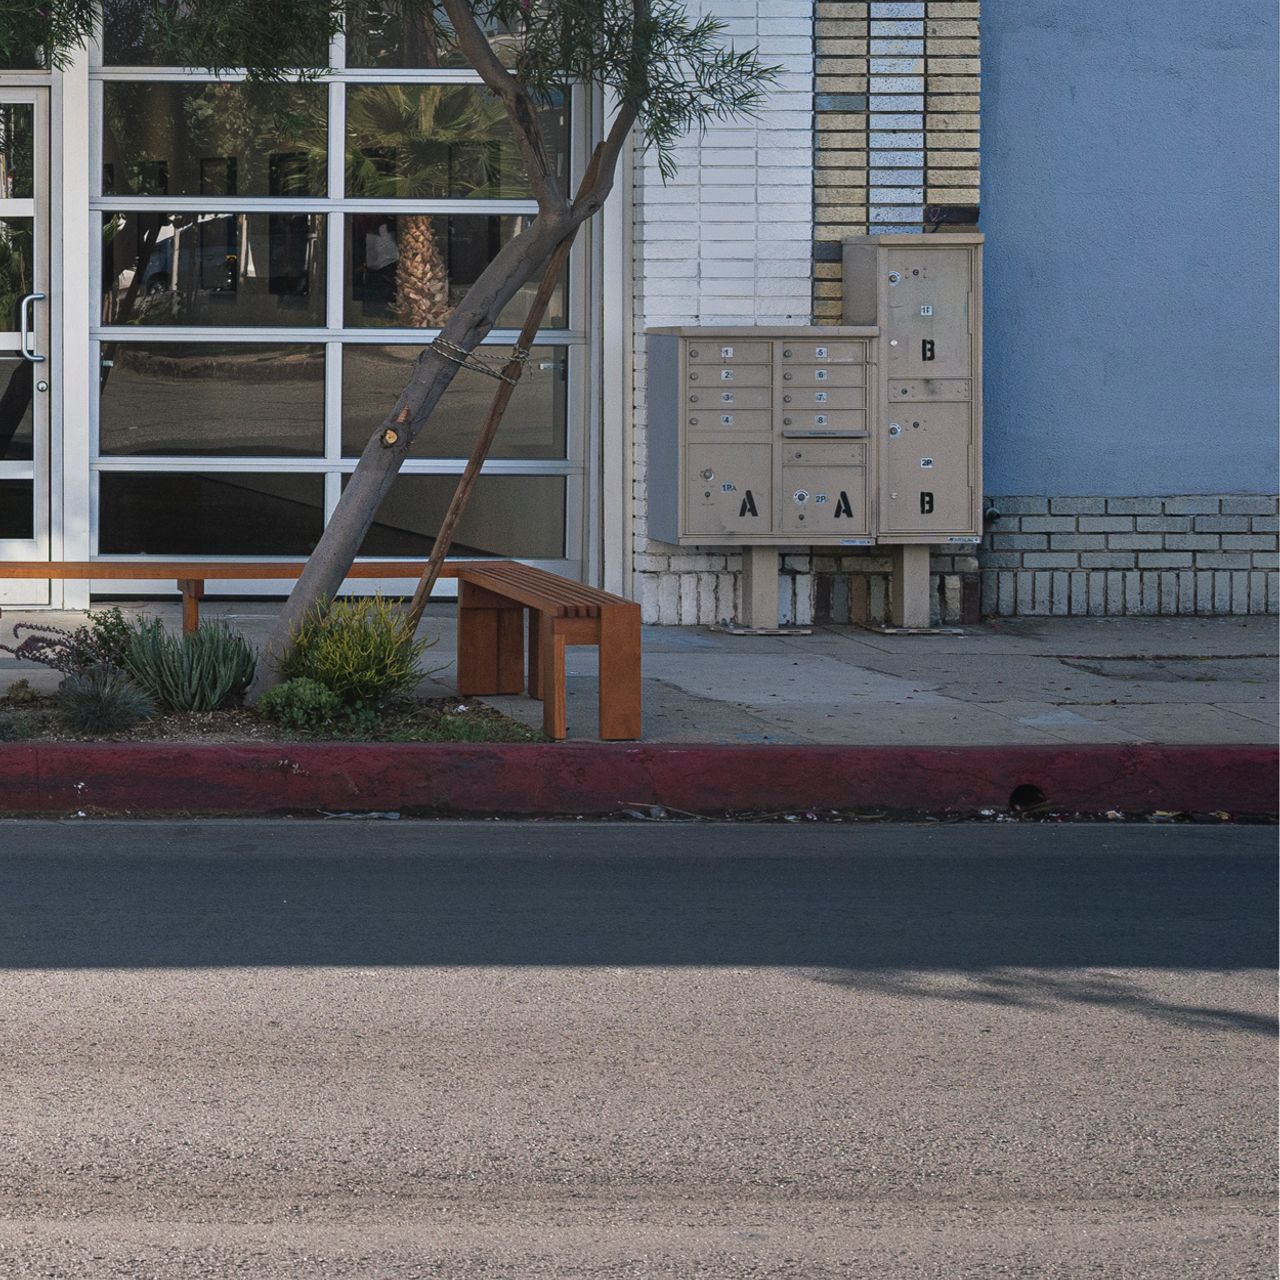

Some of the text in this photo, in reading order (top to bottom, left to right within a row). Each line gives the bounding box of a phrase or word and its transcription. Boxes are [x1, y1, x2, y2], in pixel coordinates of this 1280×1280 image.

[921, 339, 935, 361] B
[738, 489, 759, 517] A
[833, 490, 854, 519] A
[920, 491, 934, 515] B
